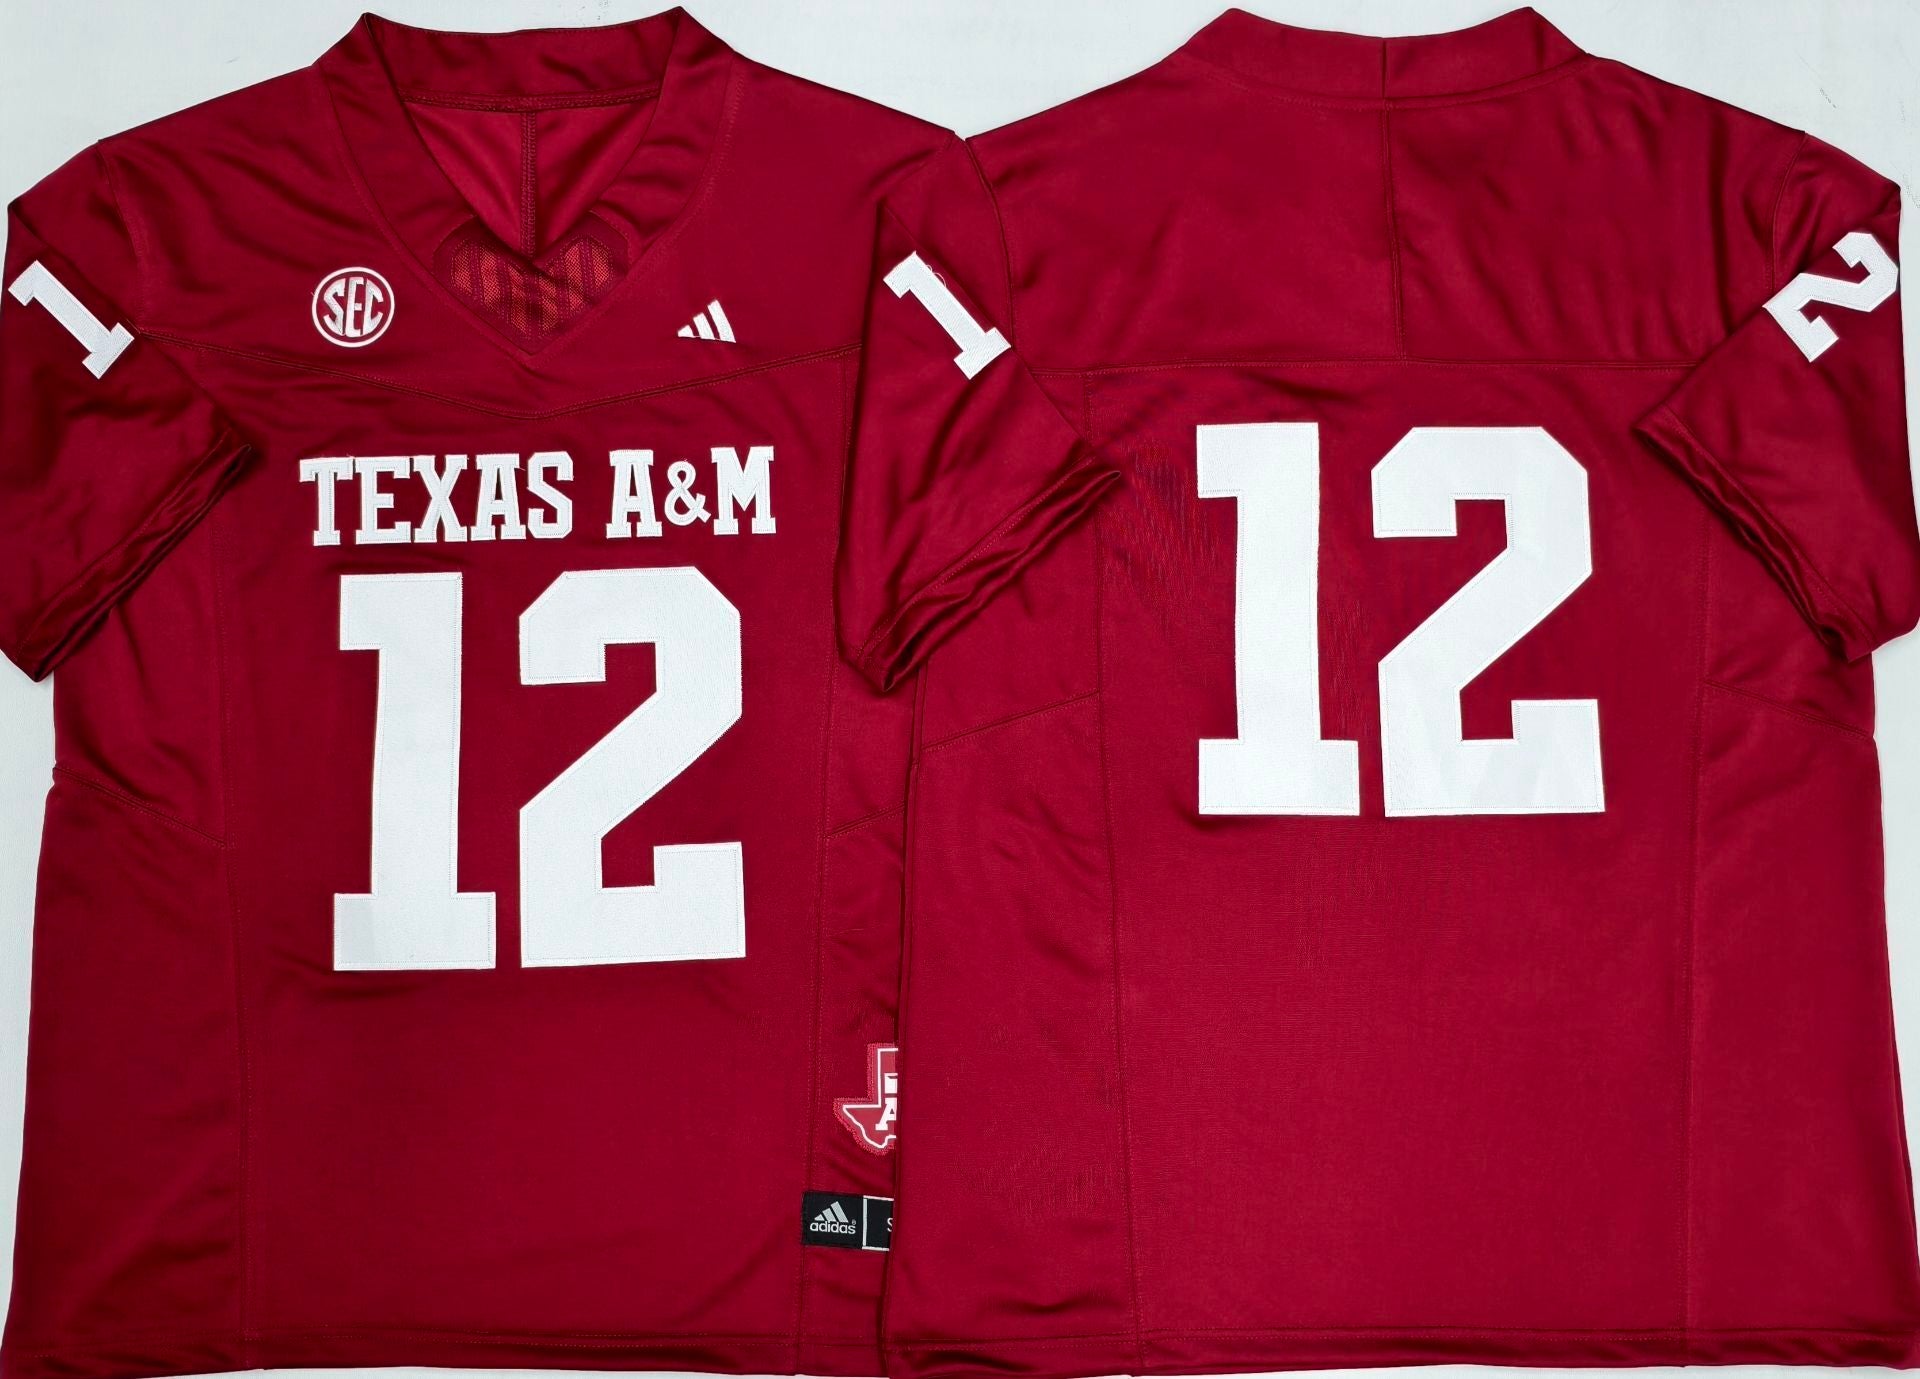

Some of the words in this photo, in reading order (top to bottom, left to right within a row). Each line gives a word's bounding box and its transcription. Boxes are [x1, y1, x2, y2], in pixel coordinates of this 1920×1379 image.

[8, 260, 134, 379] 1
[323, 276, 384, 338] SEC
[883, 251, 1011, 379] 1
[300, 451, 575, 547] TEXAS
[606, 446, 777, 540] A&M
[1196, 421, 1605, 817] 12
[334, 566, 746, 971] 12
[809, 1219, 856, 1235] adidas
